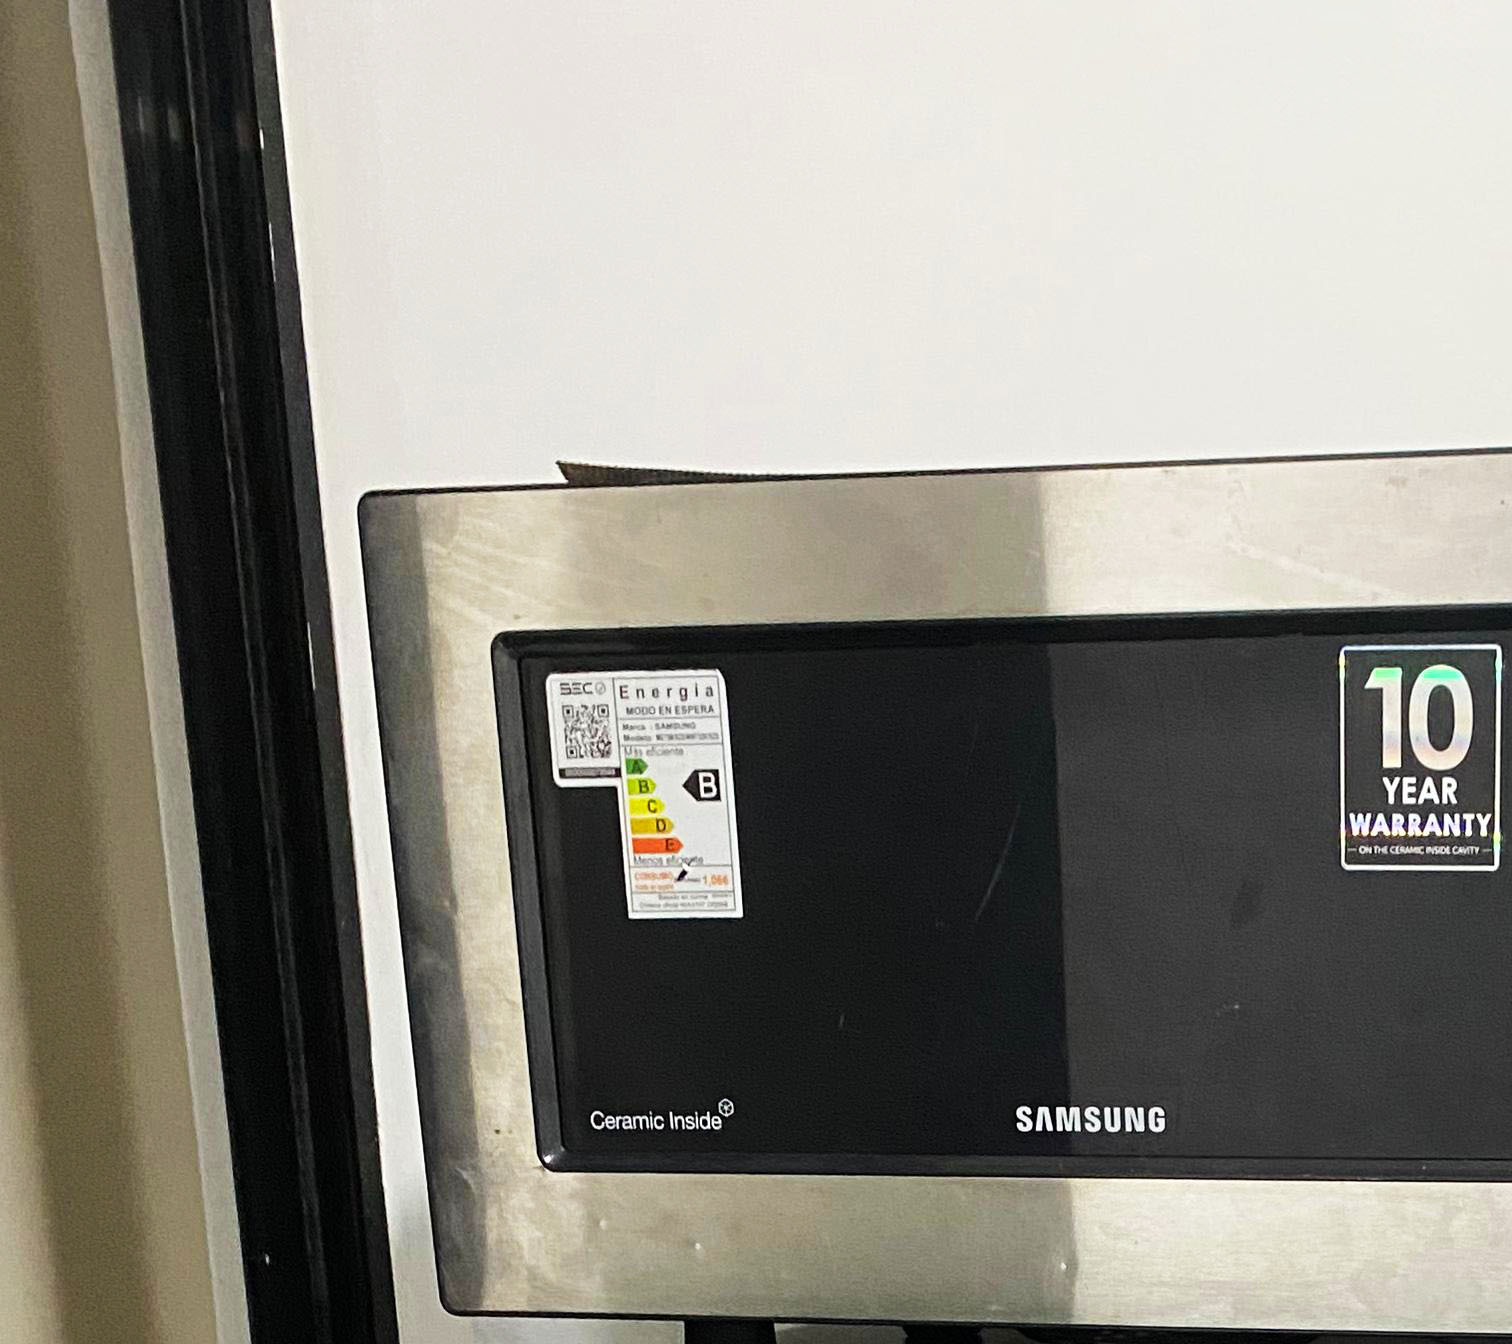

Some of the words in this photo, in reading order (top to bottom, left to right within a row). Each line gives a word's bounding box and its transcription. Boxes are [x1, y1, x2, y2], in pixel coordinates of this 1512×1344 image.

[658, 705, 672, 715] EN
[1364, 664, 1474, 771] 10
[638, 780, 650, 793] B
[700, 772, 718, 798] B
[1382, 776, 1458, 805] YEAR
[647, 800, 658, 813] C
[1349, 812, 1492, 838] WARRANTY
[590, 1110, 665, 1131] Ceramic
[669, 1111, 722, 1131] Inside
[1015, 1105, 1167, 1134] SAMSUNG
